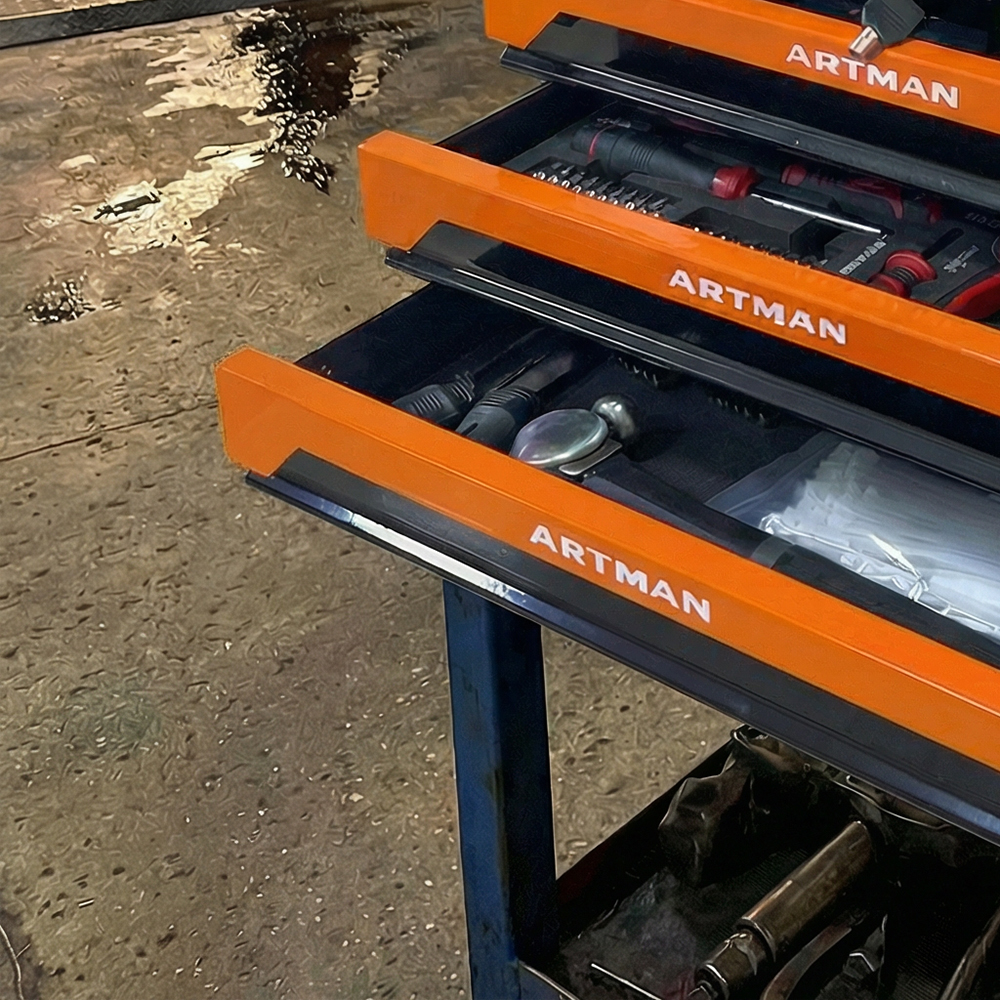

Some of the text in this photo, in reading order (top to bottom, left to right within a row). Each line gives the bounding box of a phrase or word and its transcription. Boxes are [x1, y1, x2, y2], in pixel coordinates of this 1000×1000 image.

[786, 43, 959, 110] ARTMAN
[668, 268, 847, 346] ARTMAN
[529, 524, 712, 624] ARTMAN
